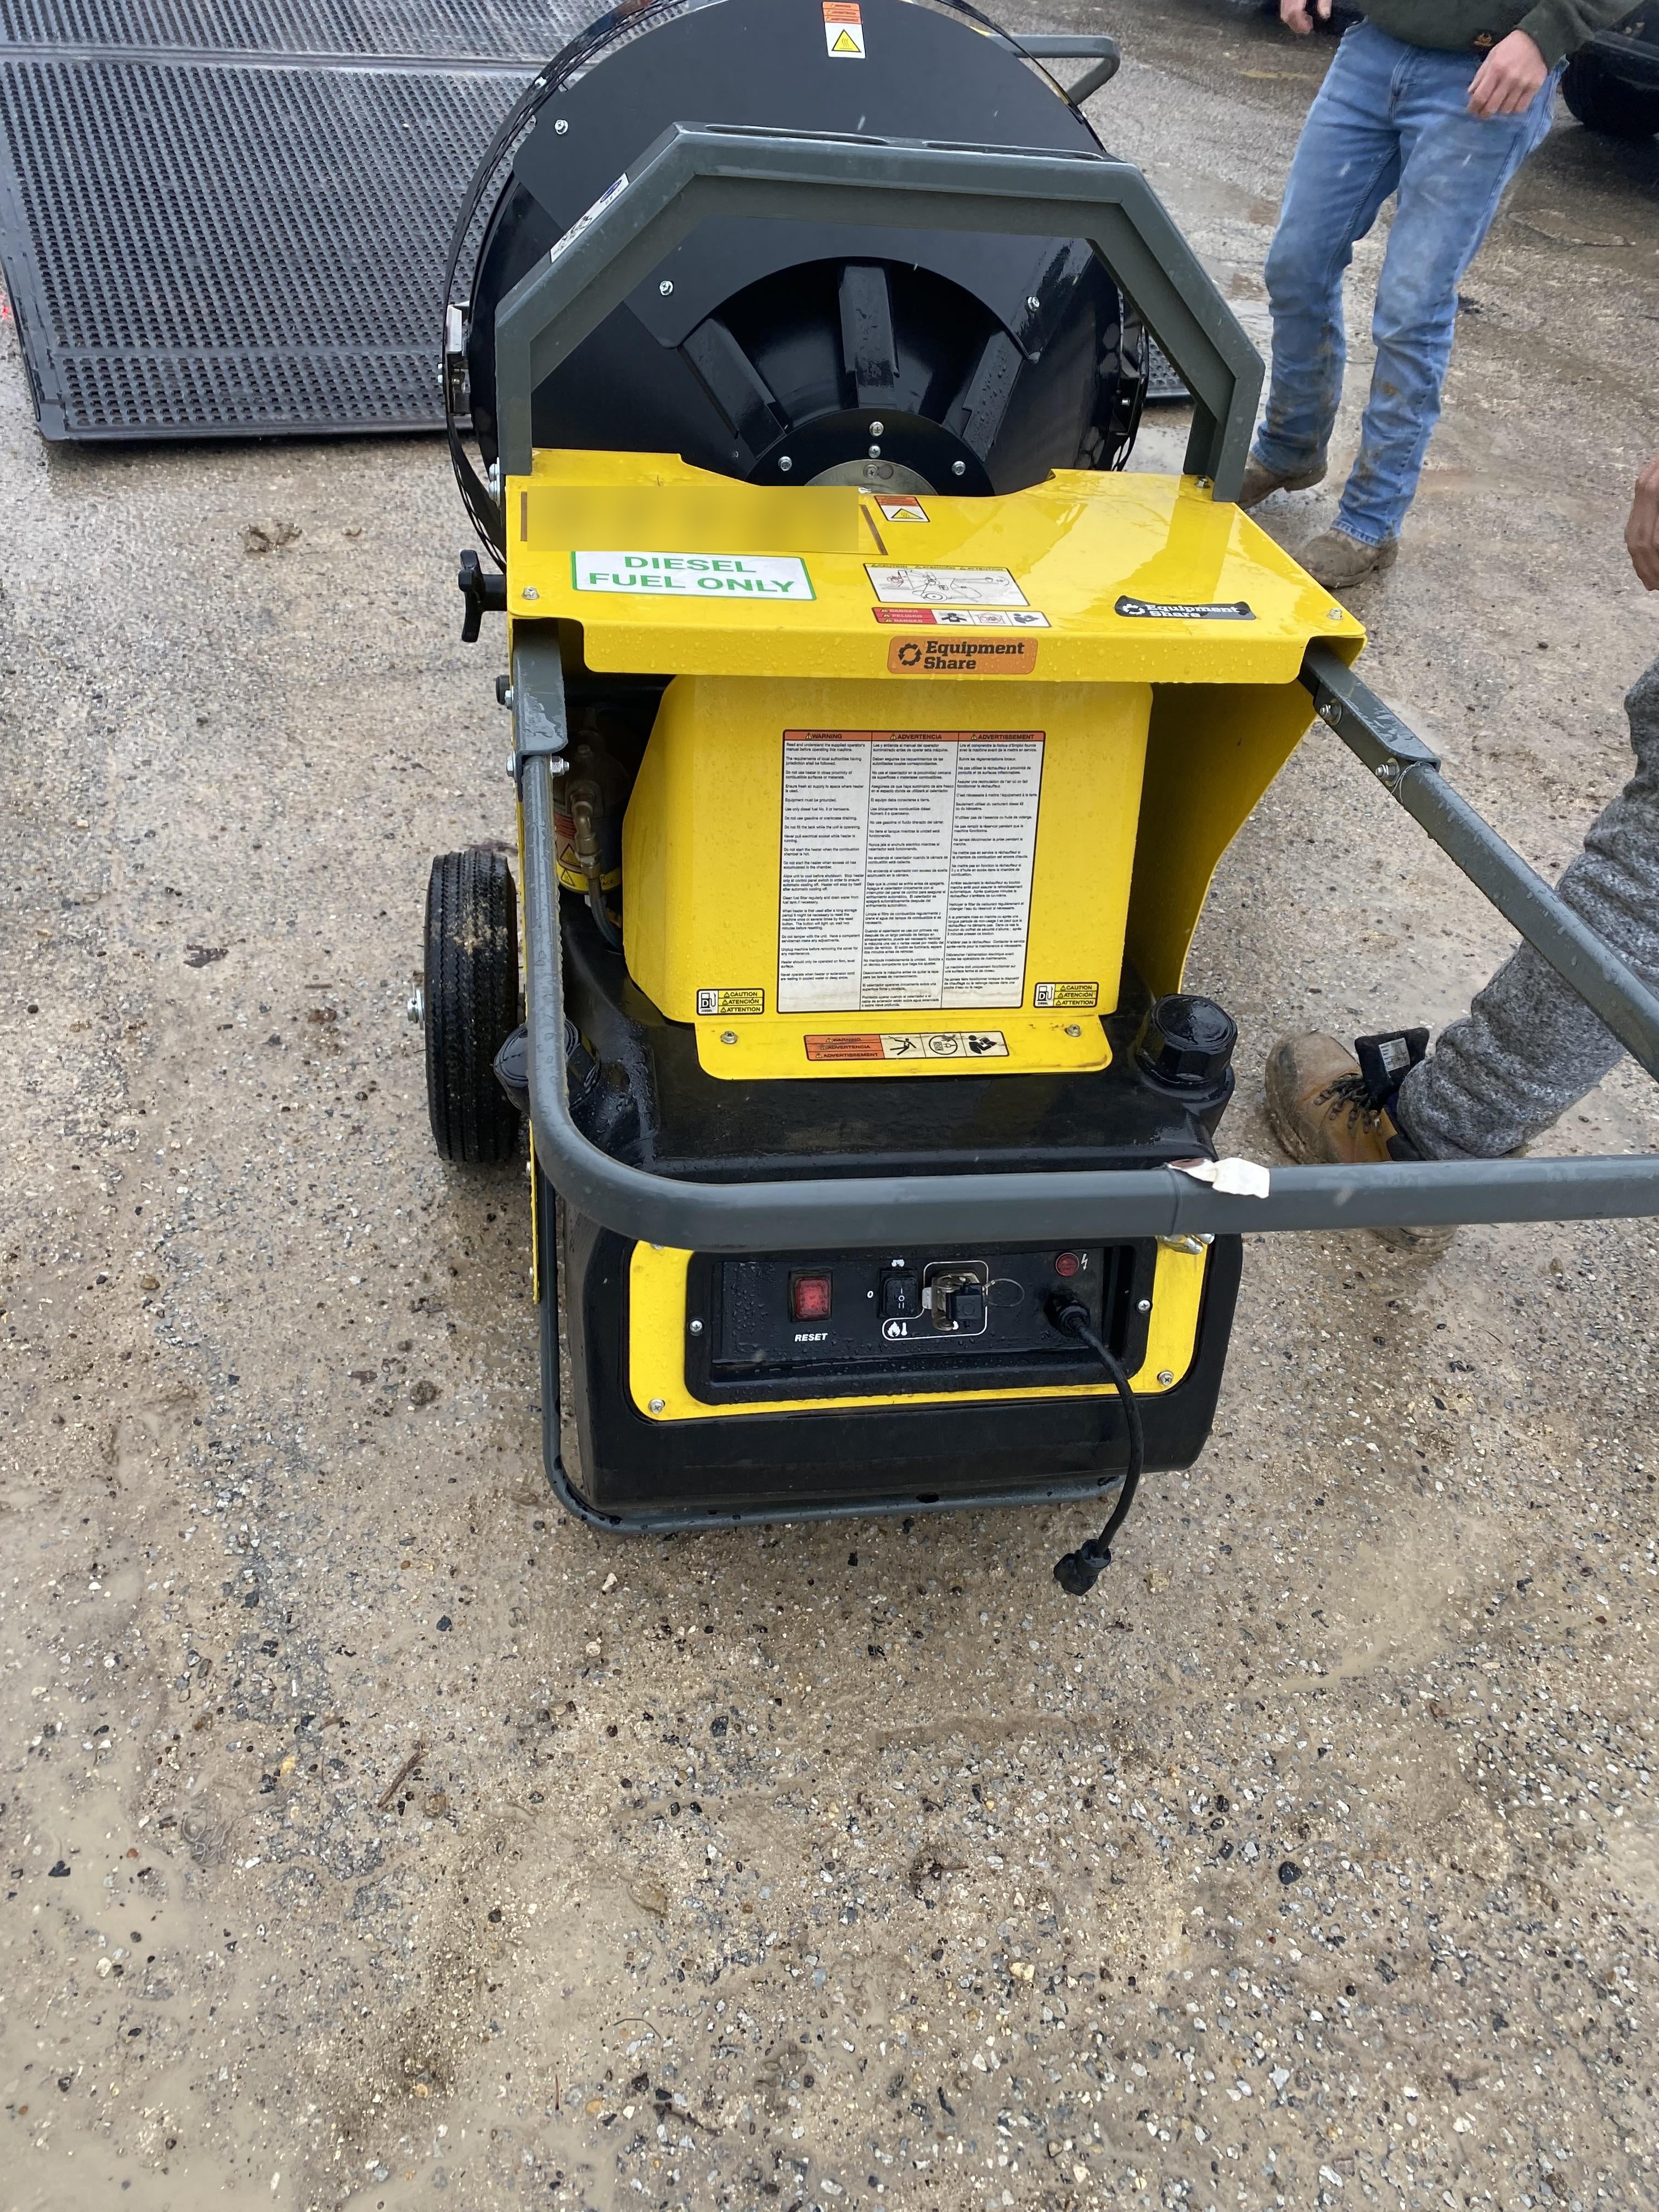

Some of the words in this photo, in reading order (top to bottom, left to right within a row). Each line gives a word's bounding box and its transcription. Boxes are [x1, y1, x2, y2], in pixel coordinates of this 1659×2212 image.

[624, 556, 757, 573] DIESEL
[589, 572, 686, 589] FUEL
[697, 577, 795, 592] ONLY
[1146, 604, 1240, 614] Equipment
[926, 641, 1025, 656] Equipment
[924, 656, 977, 669] Share
[794, 1333, 828, 1342] RESET
